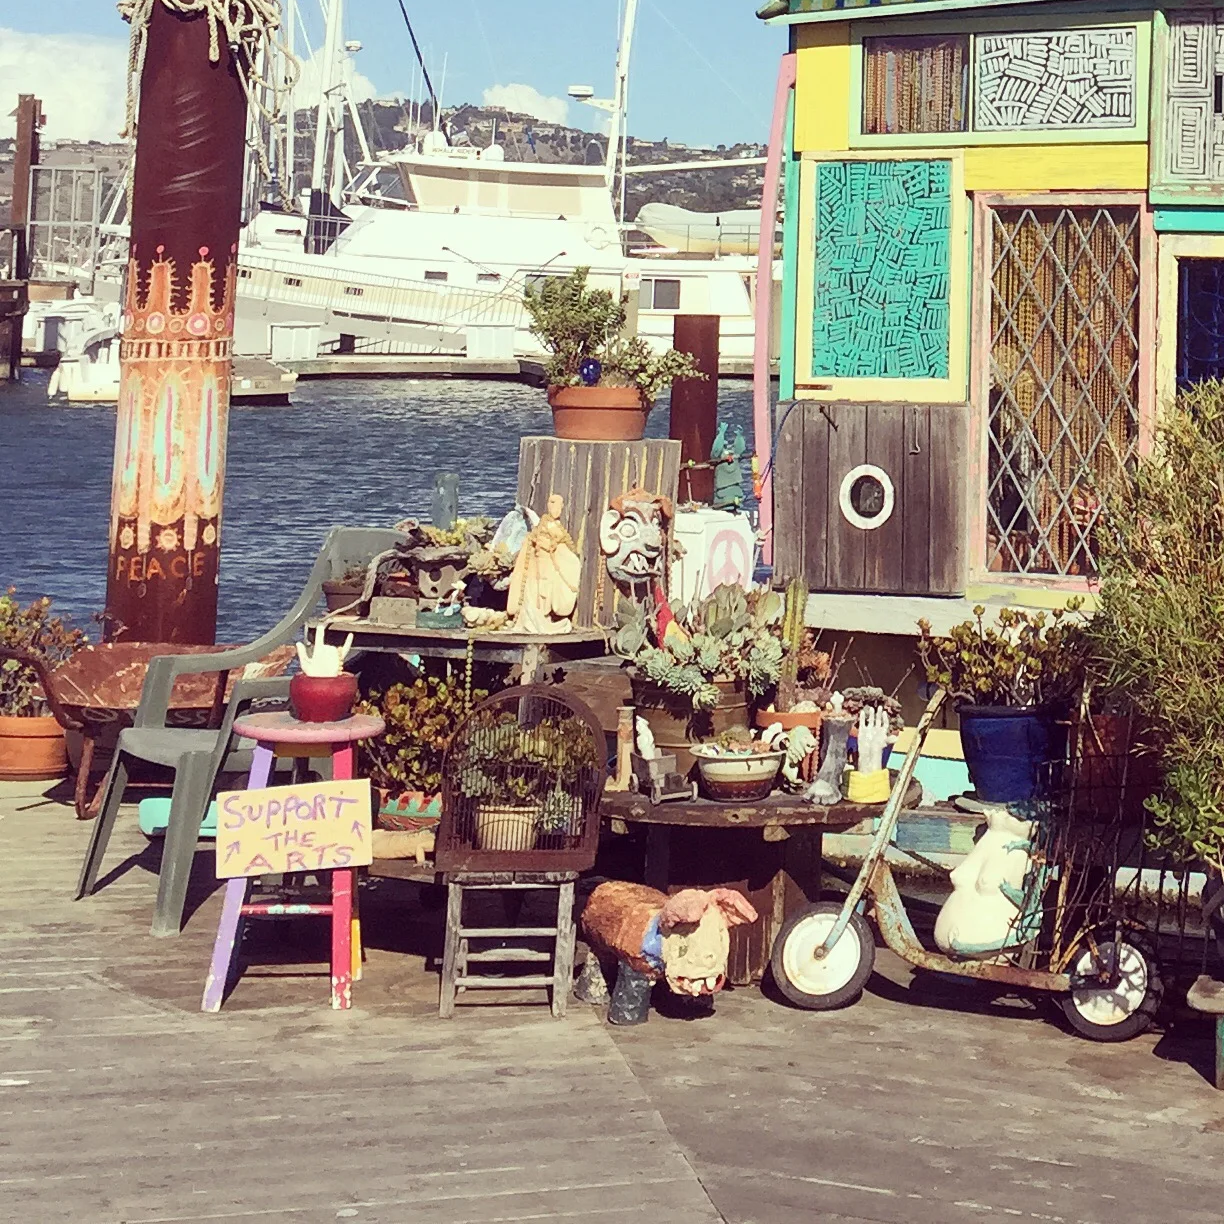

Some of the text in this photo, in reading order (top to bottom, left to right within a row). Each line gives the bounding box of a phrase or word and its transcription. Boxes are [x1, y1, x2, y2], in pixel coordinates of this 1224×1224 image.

[115, 551, 206, 581] PEACE
[223, 792, 359, 830] SUPPORT
[261, 829, 317, 852] THE
[243, 842, 355, 874] ARTS
